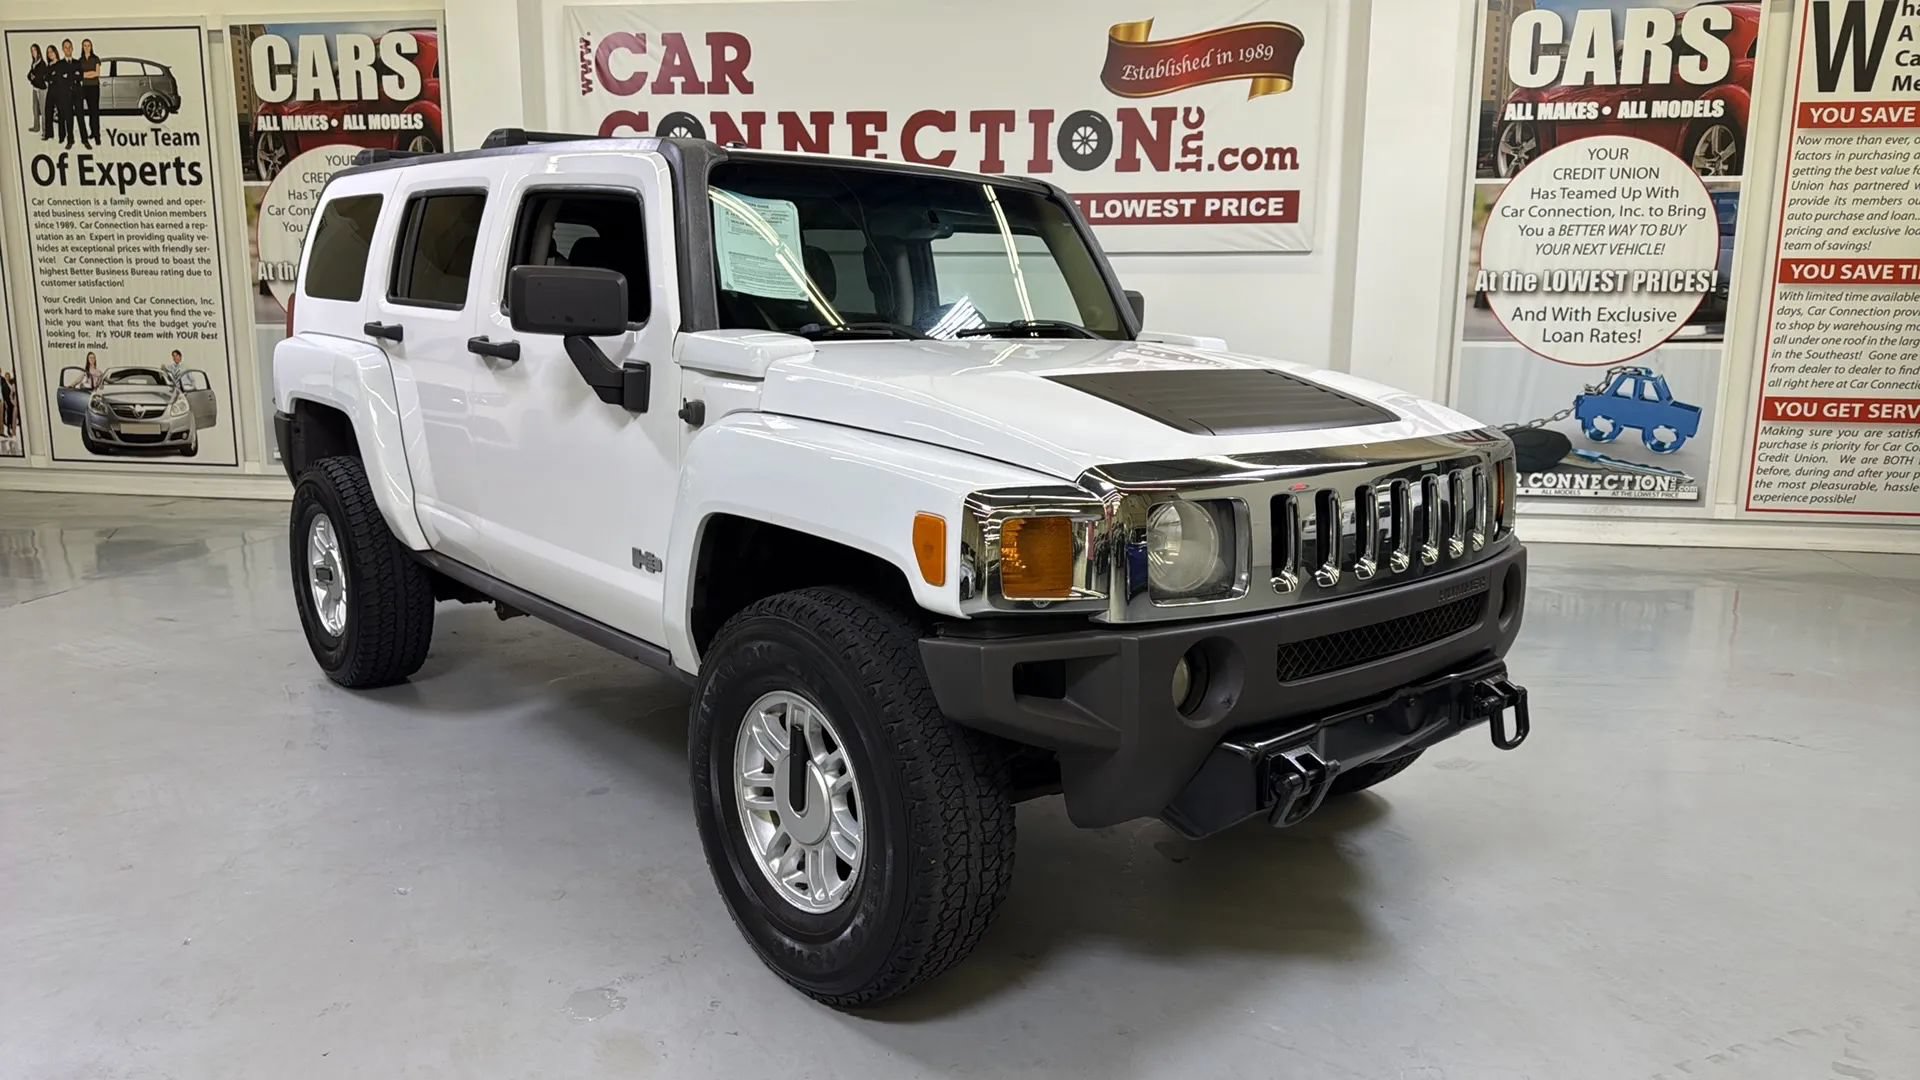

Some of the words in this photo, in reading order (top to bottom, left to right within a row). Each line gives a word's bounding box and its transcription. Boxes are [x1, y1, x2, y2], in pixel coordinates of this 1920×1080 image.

[1898, 25, 1913, 41] A
[1508, 6, 1732, 88] CARS
[250, 32, 421, 102] CARS
[595, 32, 754, 96] CAR
[1121, 48, 1214, 81] Established
[1216, 49, 1233, 65] in
[1238, 44, 1274, 62] 1989
[1504, 103, 1534, 120] ALL
[1537, 102, 1599, 120] MAKES
[1617, 100, 1648, 118] ALL
[1652, 100, 1724, 118] MODELS
[1810, 108, 1855, 123] YOU
[1861, 107, 1916, 123] SAVE
[257, 116, 280, 131] ALL
[282, 115, 328, 131] MAKES
[343, 114, 366, 130] ALL
[369, 113, 423, 130] MODELS
[106, 129, 147, 146] Your
[152, 128, 200, 146] Team
[1796, 136, 1821, 145] Now
[1856, 136, 1882, 145] than
[1886, 138, 1910, 147] ever,
[1588, 148, 1629, 160] YOUR
[1794, 151, 1831, 160] factors
[1835, 151, 1844, 160] in
[1848, 151, 1910, 162] purchasing
[31, 153, 68, 186] Of
[78, 154, 203, 194] Experts
[1553, 168, 1606, 180] CREDIT
[1610, 168, 1660, 179] UNION
[1792, 166, 1831, 177] getting
[1835, 166, 1852, 175] the
[1855, 166, 1880, 175] best
[1882, 166, 1909, 175] value
[288, 190, 309, 200] Has
[1530, 188, 1556, 200] Has
[1560, 188, 1617, 200] Teamed
[1621, 188, 1642, 202] Up
[1646, 187, 1679, 199] With
[32, 198, 45, 206] Car
[48, 198, 91, 206] Connection
[94, 198, 100, 206] is
[110, 198, 134, 207] family
[137, 198, 163, 206] owned
[167, 198, 181, 206] and
[184, 199, 205, 208] oper-
[1090, 199, 1196, 218] LOWEST
[1205, 198, 1284, 216] PRICE
[88, 210, 116, 219] serving
[268, 205, 286, 216] Car
[1501, 206, 1524, 217] Car
[1528, 206, 1615, 220] Connection,
[1620, 206, 1644, 217] Inc.
[1649, 207, 1663, 217] to
[1668, 205, 1706, 220] Bring
[192, 223, 208, 231] rep-
[283, 222, 303, 232] You
[1518, 224, 1544, 236] You
[1548, 228, 1554, 236] a
[1558, 224, 1605, 236] BETTER
[1608, 224, 1636, 236] WAY
[1641, 224, 1656, 236] TO
[1660, 224, 1686, 236] BUY
[1536, 244, 1570, 255] YOUR
[1572, 244, 1608, 255] NEXT
[1610, 243, 1665, 255] VEHICLE!
[1784, 241, 1812, 250] team
[1814, 240, 1826, 250] of
[1828, 240, 1872, 252] savings!
[258, 260, 274, 280] At
[1791, 264, 1834, 280] YOU
[1840, 264, 1894, 280] SAVE
[1475, 270, 1497, 292] At
[1502, 270, 1536, 292] the
[1542, 270, 1627, 292] LOWEST
[1632, 270, 1718, 292] PRICES!
[1779, 292, 1804, 301] With
[1806, 292, 1842, 301] limited
[1844, 292, 1869, 302] time
[1870, 292, 1920, 302] available
[1512, 307, 1546, 322] And
[1552, 307, 1592, 322] With
[1598, 307, 1677, 322] Exclusive
[47, 330, 75, 339] looking
[78, 330, 90, 338] for.
[96, 330, 106, 338] It's
[110, 330, 131, 338] YOUR
[156, 330, 173, 339] with
[176, 331, 198, 339] YOUR
[201, 331, 217, 339] best
[1542, 329, 1584, 342] Loan
[1590, 329, 1642, 343] Rates!
[48, 341, 76, 349] interest
[78, 341, 85, 349] in
[87, 341, 108, 349] mind.
[1774, 402, 1817, 417] YOU
[1823, 402, 1864, 418] GET
[1761, 427, 1804, 438] Making
[1838, 430, 1860, 440] you
[1756, 466, 1791, 476] before,
[1795, 468, 1830, 478] during
[1834, 468, 1854, 477] and
[1858, 468, 1882, 478] after
[1886, 471, 1910, 480] your
[1528, 472, 1671, 491] CONNECTION
[1752, 494, 1808, 504] experience
[1810, 494, 1856, 504] possible!
